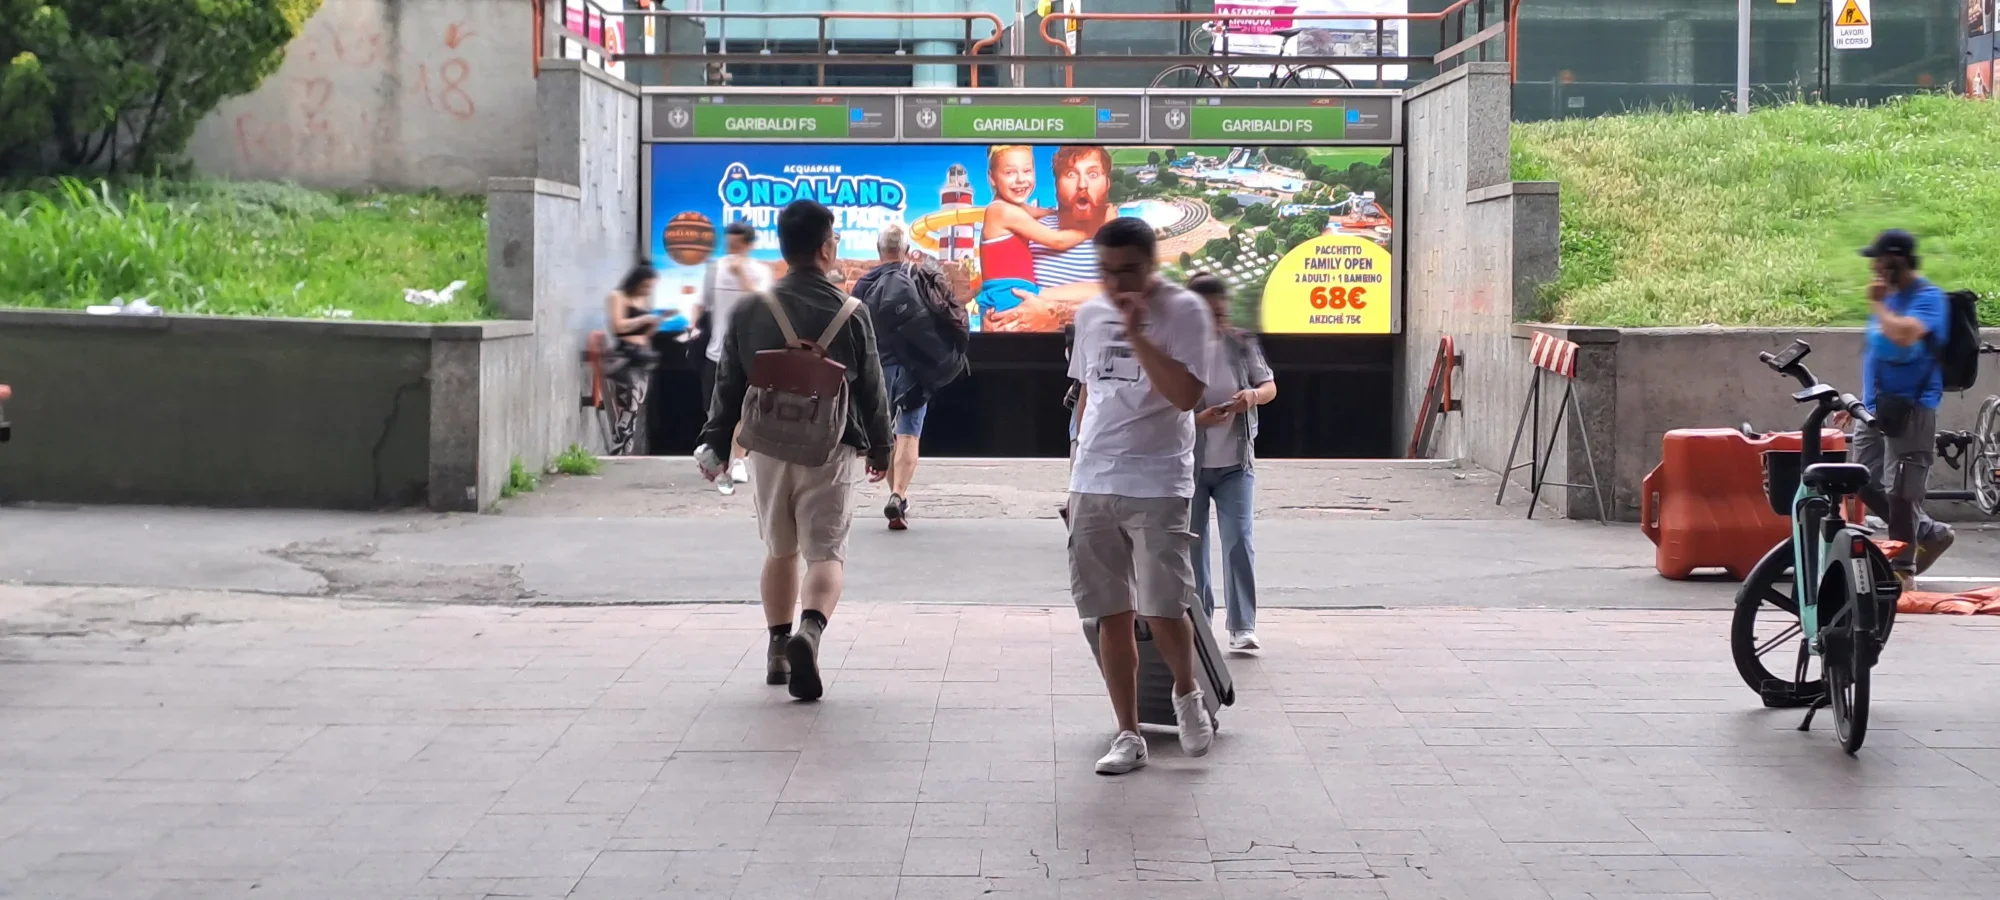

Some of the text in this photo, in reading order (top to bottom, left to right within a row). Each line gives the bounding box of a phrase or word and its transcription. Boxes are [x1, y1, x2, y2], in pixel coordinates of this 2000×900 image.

[1845, 37, 1869, 45] CORSO
[725, 117, 816, 131] GARIBALDI FS
[973, 118, 1064, 131] GARIBALDI FS
[1222, 119, 1313, 132] GARIBALDI FS
[783, 164, 842, 174] ACQUAPARK
[723, 178, 904, 206] ONDALAND
[1315, 245, 1362, 255] PACCHETTO
[1304, 257, 1373, 270] FAMILY OPEN
[1295, 274, 1300, 283] 2
[1301, 273, 1330, 283] ADULTI
[1337, 273, 1342, 283] 1
[1344, 273, 1383, 283] BAMBINO
[1310, 286, 1367, 310] 68€
[1309, 312, 1362, 324] ANZICHÉ 75€
